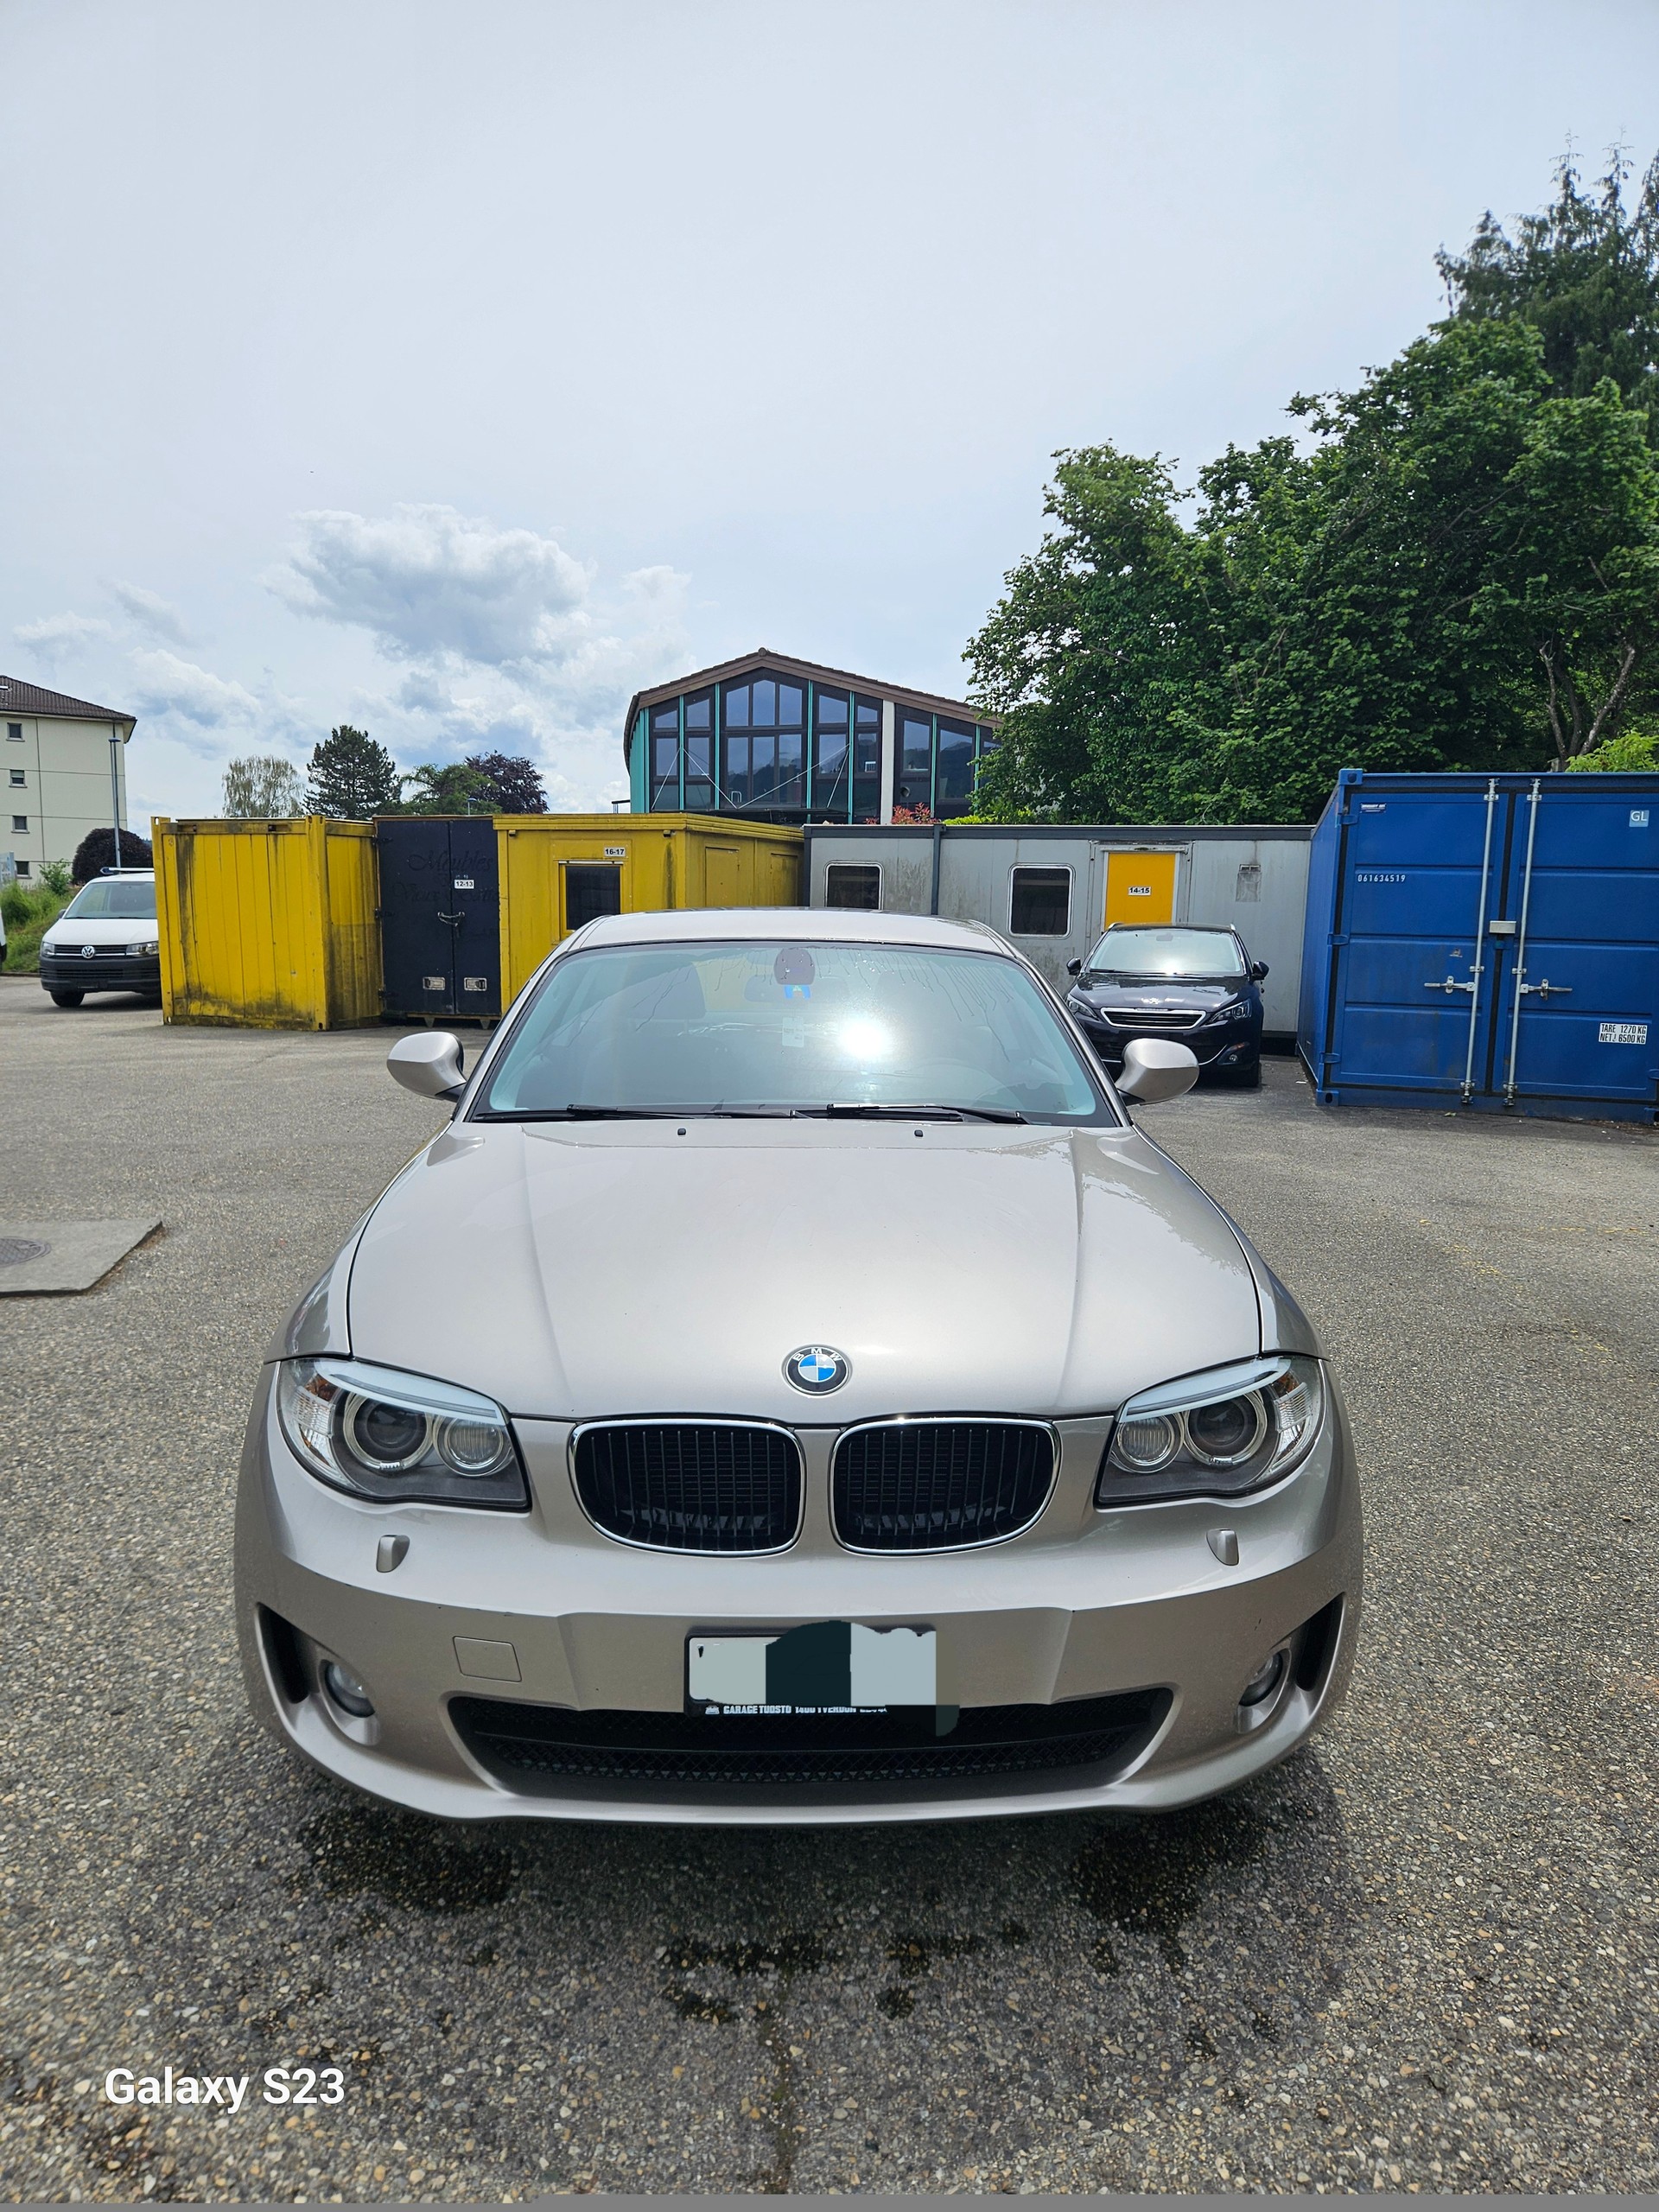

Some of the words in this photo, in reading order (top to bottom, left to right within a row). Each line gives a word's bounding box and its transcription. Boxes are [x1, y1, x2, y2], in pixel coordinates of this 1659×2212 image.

[1630, 810, 1647, 821] GL
[1357, 874, 1406, 882] 061634519
[1601, 1024, 1617, 1033] TARE
[1621, 1025, 1637, 1034] 1270
[1637, 1026, 1647, 1035] KG
[1618, 1033, 1636, 1043] 6500
[1637, 1034, 1646, 1044] KG
[792, 1347, 842, 1362] BMW
[723, 1705, 759, 1714] GARAGE
